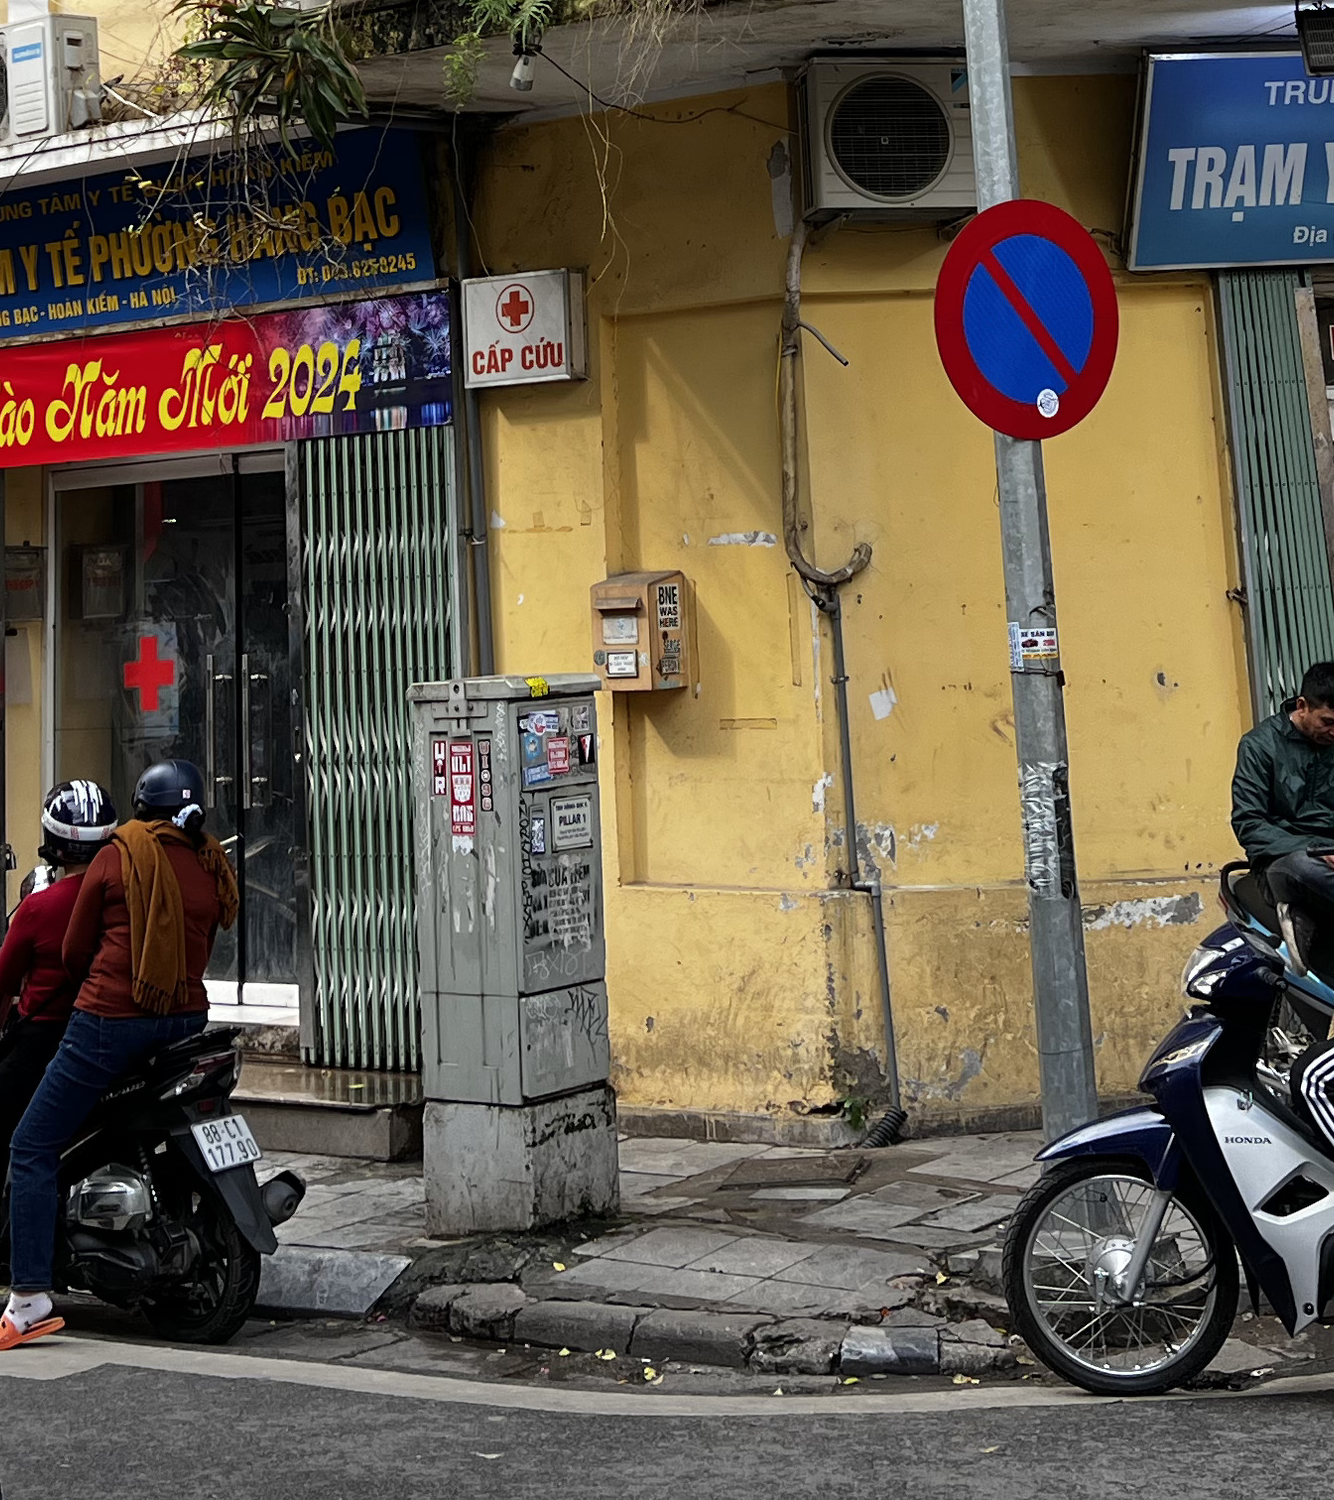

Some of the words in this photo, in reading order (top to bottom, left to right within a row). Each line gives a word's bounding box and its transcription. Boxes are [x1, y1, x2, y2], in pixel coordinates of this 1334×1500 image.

[1168, 143, 1308, 222] TRẠM
[38, 192, 81, 215] TÂM
[87, 190, 102, 207] Y
[19, 244, 39, 291] Y
[45, 221, 86, 289] TẾ
[88, 212, 218, 283] PHƯỜNG
[327, 185, 401, 252] BẠC
[1293, 226, 1327, 246] Địa
[14, 305, 39, 328] BẠC
[48, 298, 83, 320] HOÀN
[87, 290, 120, 315] KIẾM
[130, 287, 148, 309] HÀ
[152, 285, 177, 308] NỘI
[472, 338, 517, 376] CẤP
[524, 334, 564, 370] CỨU
[44, 357, 147, 442] Năm
[158, 343, 254, 433] Mới
[261, 339, 362, 421] 2024
[658, 586, 678, 605] BNE
[659, 606, 679, 617] WAS
[659, 617, 679, 628] HERE
[558, 813, 581, 827] PILLAR
[202, 1118, 244, 1144] 88-C1
[1224, 1136, 1272, 1145] HONDA
[208, 1138, 259, 1168] 177.90
